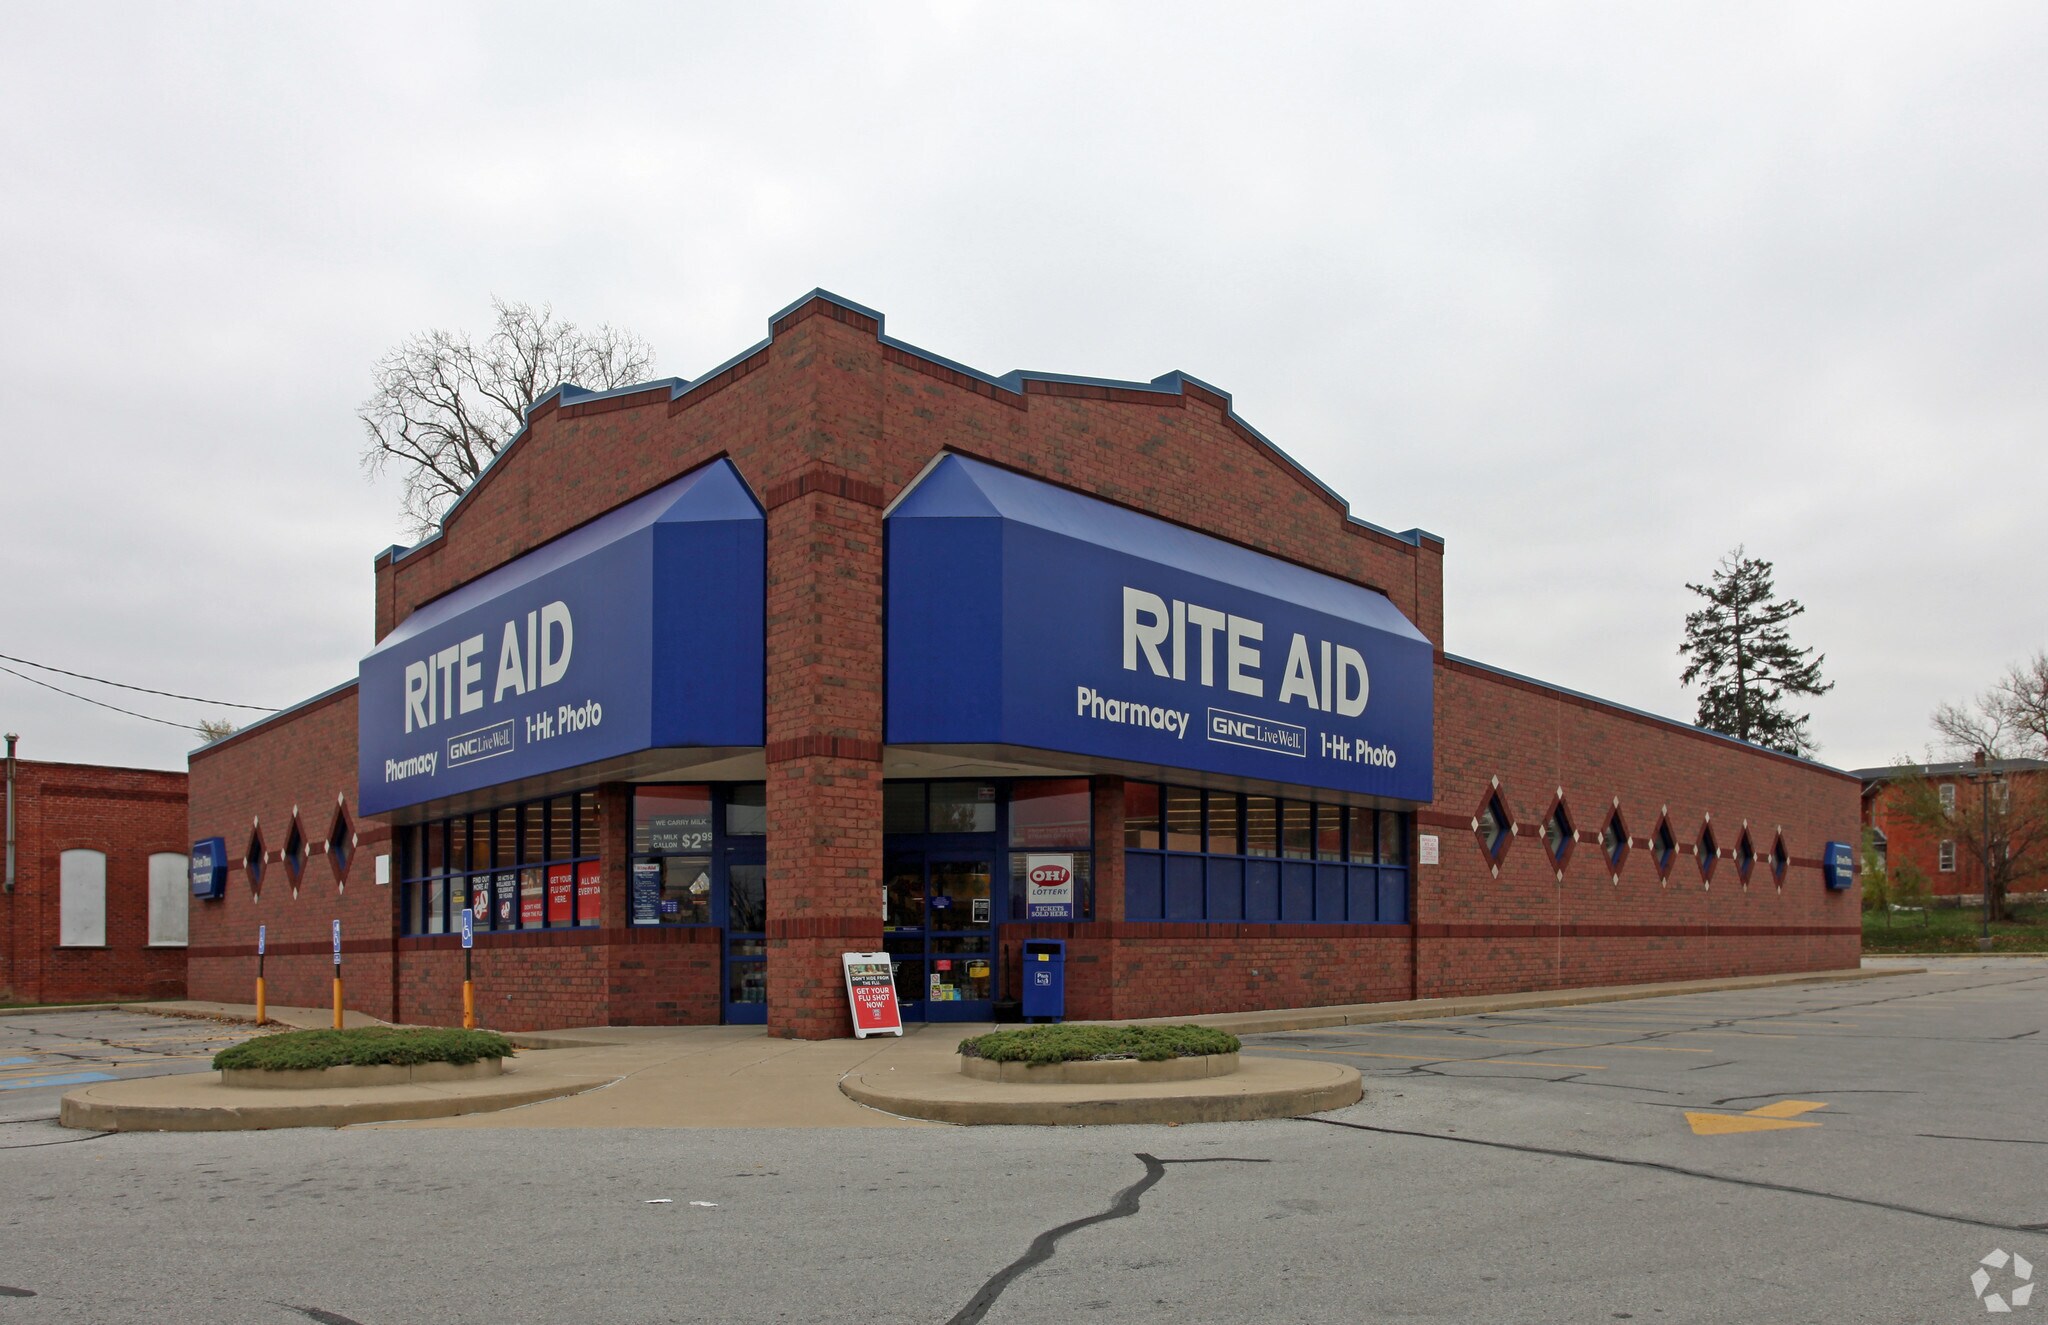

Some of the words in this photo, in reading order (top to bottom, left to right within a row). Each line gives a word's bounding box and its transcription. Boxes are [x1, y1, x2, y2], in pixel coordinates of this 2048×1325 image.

[1123, 586, 1263, 697] RITE
[1278, 633, 1370, 717] AID
[405, 633, 484, 733] RITE
[493, 600, 573, 702] AID
[526, 710, 555, 744] 1-Hr.
[558, 699, 602, 735] Photo
[1077, 686, 1189, 739] Pharmacy
[1212, 717, 1256, 740] GNC
[450, 738, 477, 760] GNC
[1320, 732, 1352, 761] 1-Hr.
[1355, 739, 1396, 768] Photo
[385, 751, 437, 783] Pharmacy
[473, 876, 482, 884] FIND
[550, 876, 559, 884] GET
[560, 875, 571, 883] YOUR
[581, 877, 590, 885] ALL
[1032, 868, 1067, 881] OH!
[473, 883, 484, 891] MORE
[551, 886, 559, 894] FLU
[559, 885, 571, 893] SHOT
[578, 887, 593, 895] EVERY
